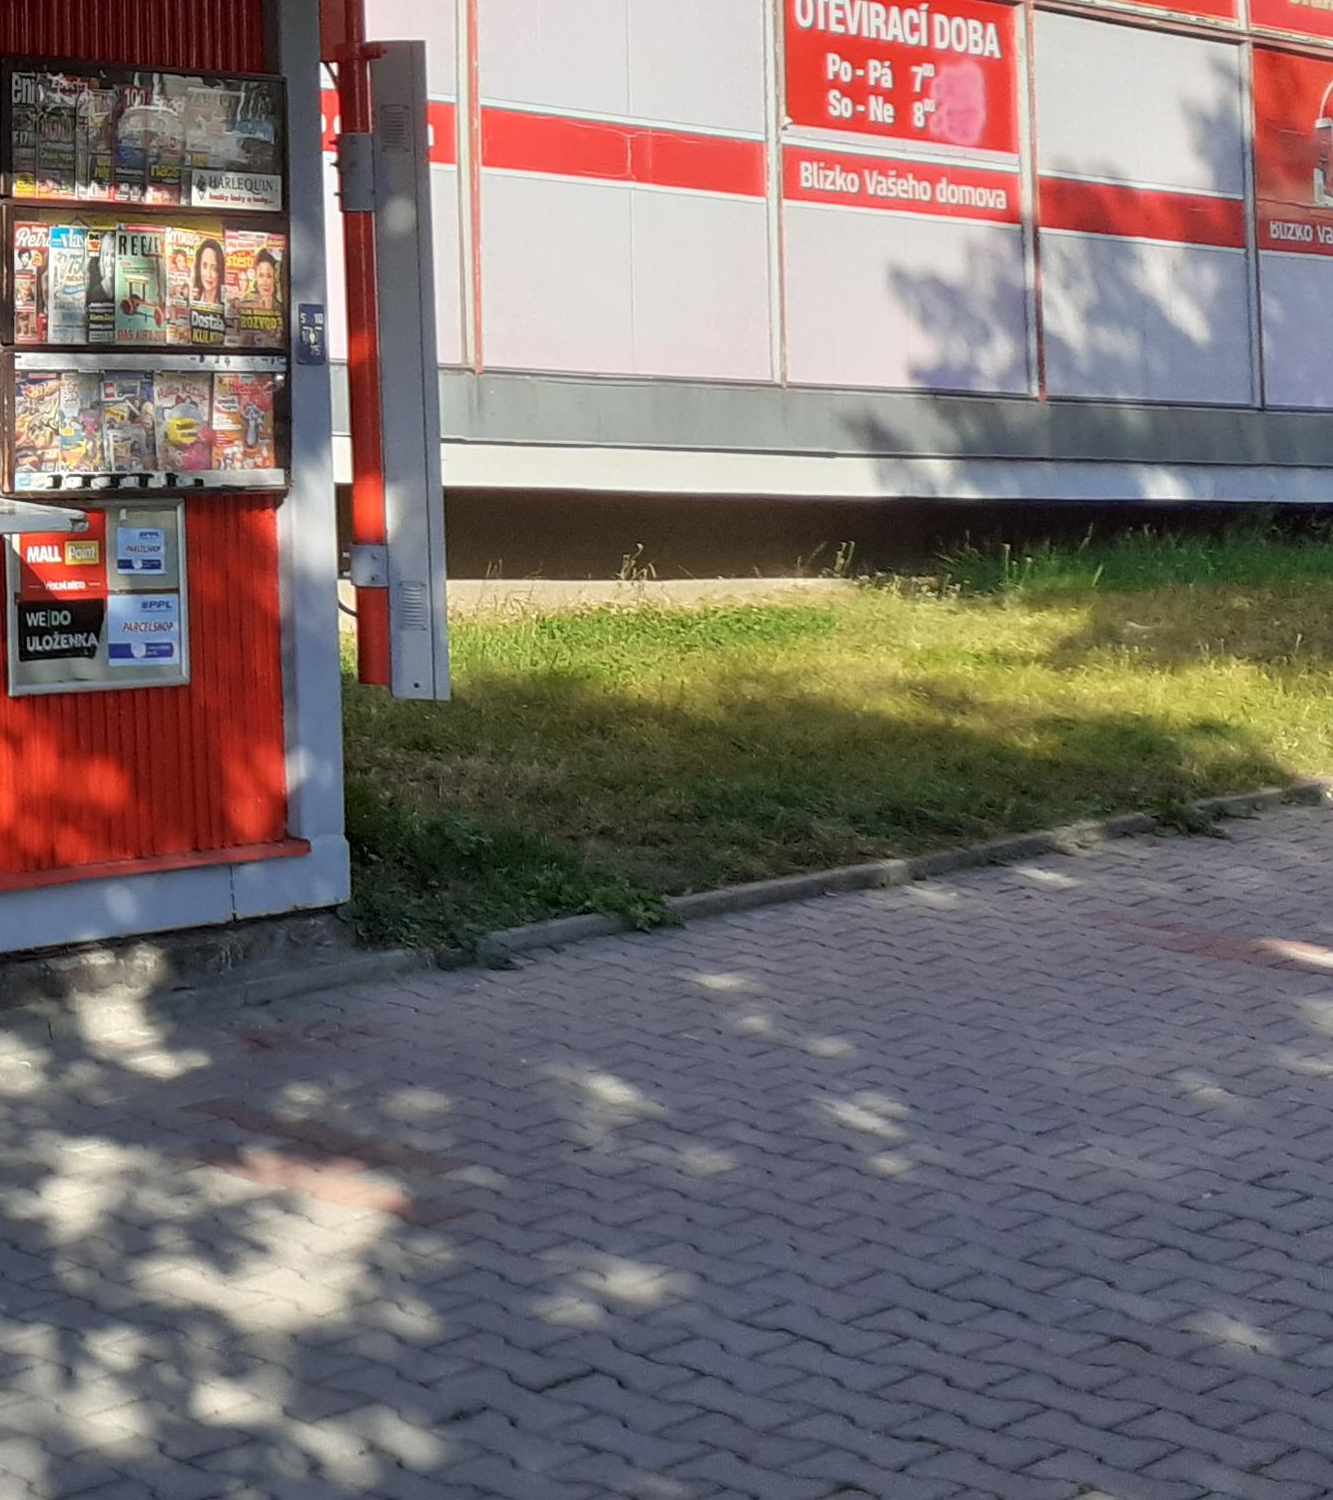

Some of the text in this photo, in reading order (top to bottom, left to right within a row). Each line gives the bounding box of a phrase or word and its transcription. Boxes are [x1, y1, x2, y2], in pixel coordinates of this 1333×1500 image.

[933, 13, 1002, 59] DOBA
[826, 52, 853, 83] Po
[868, 60, 893, 89] Pá
[828, 89, 853, 118] So
[868, 95, 895, 124] Ne
[208, 176, 275, 197] HARLEQUIN
[863, 169, 932, 201] Vašeho
[936, 177, 1008, 210] domova
[27, 545, 96, 563] MALL Point
[122, 621, 174, 632] PARCELSHOP
[26, 630, 99, 652] ULOŽENKA
